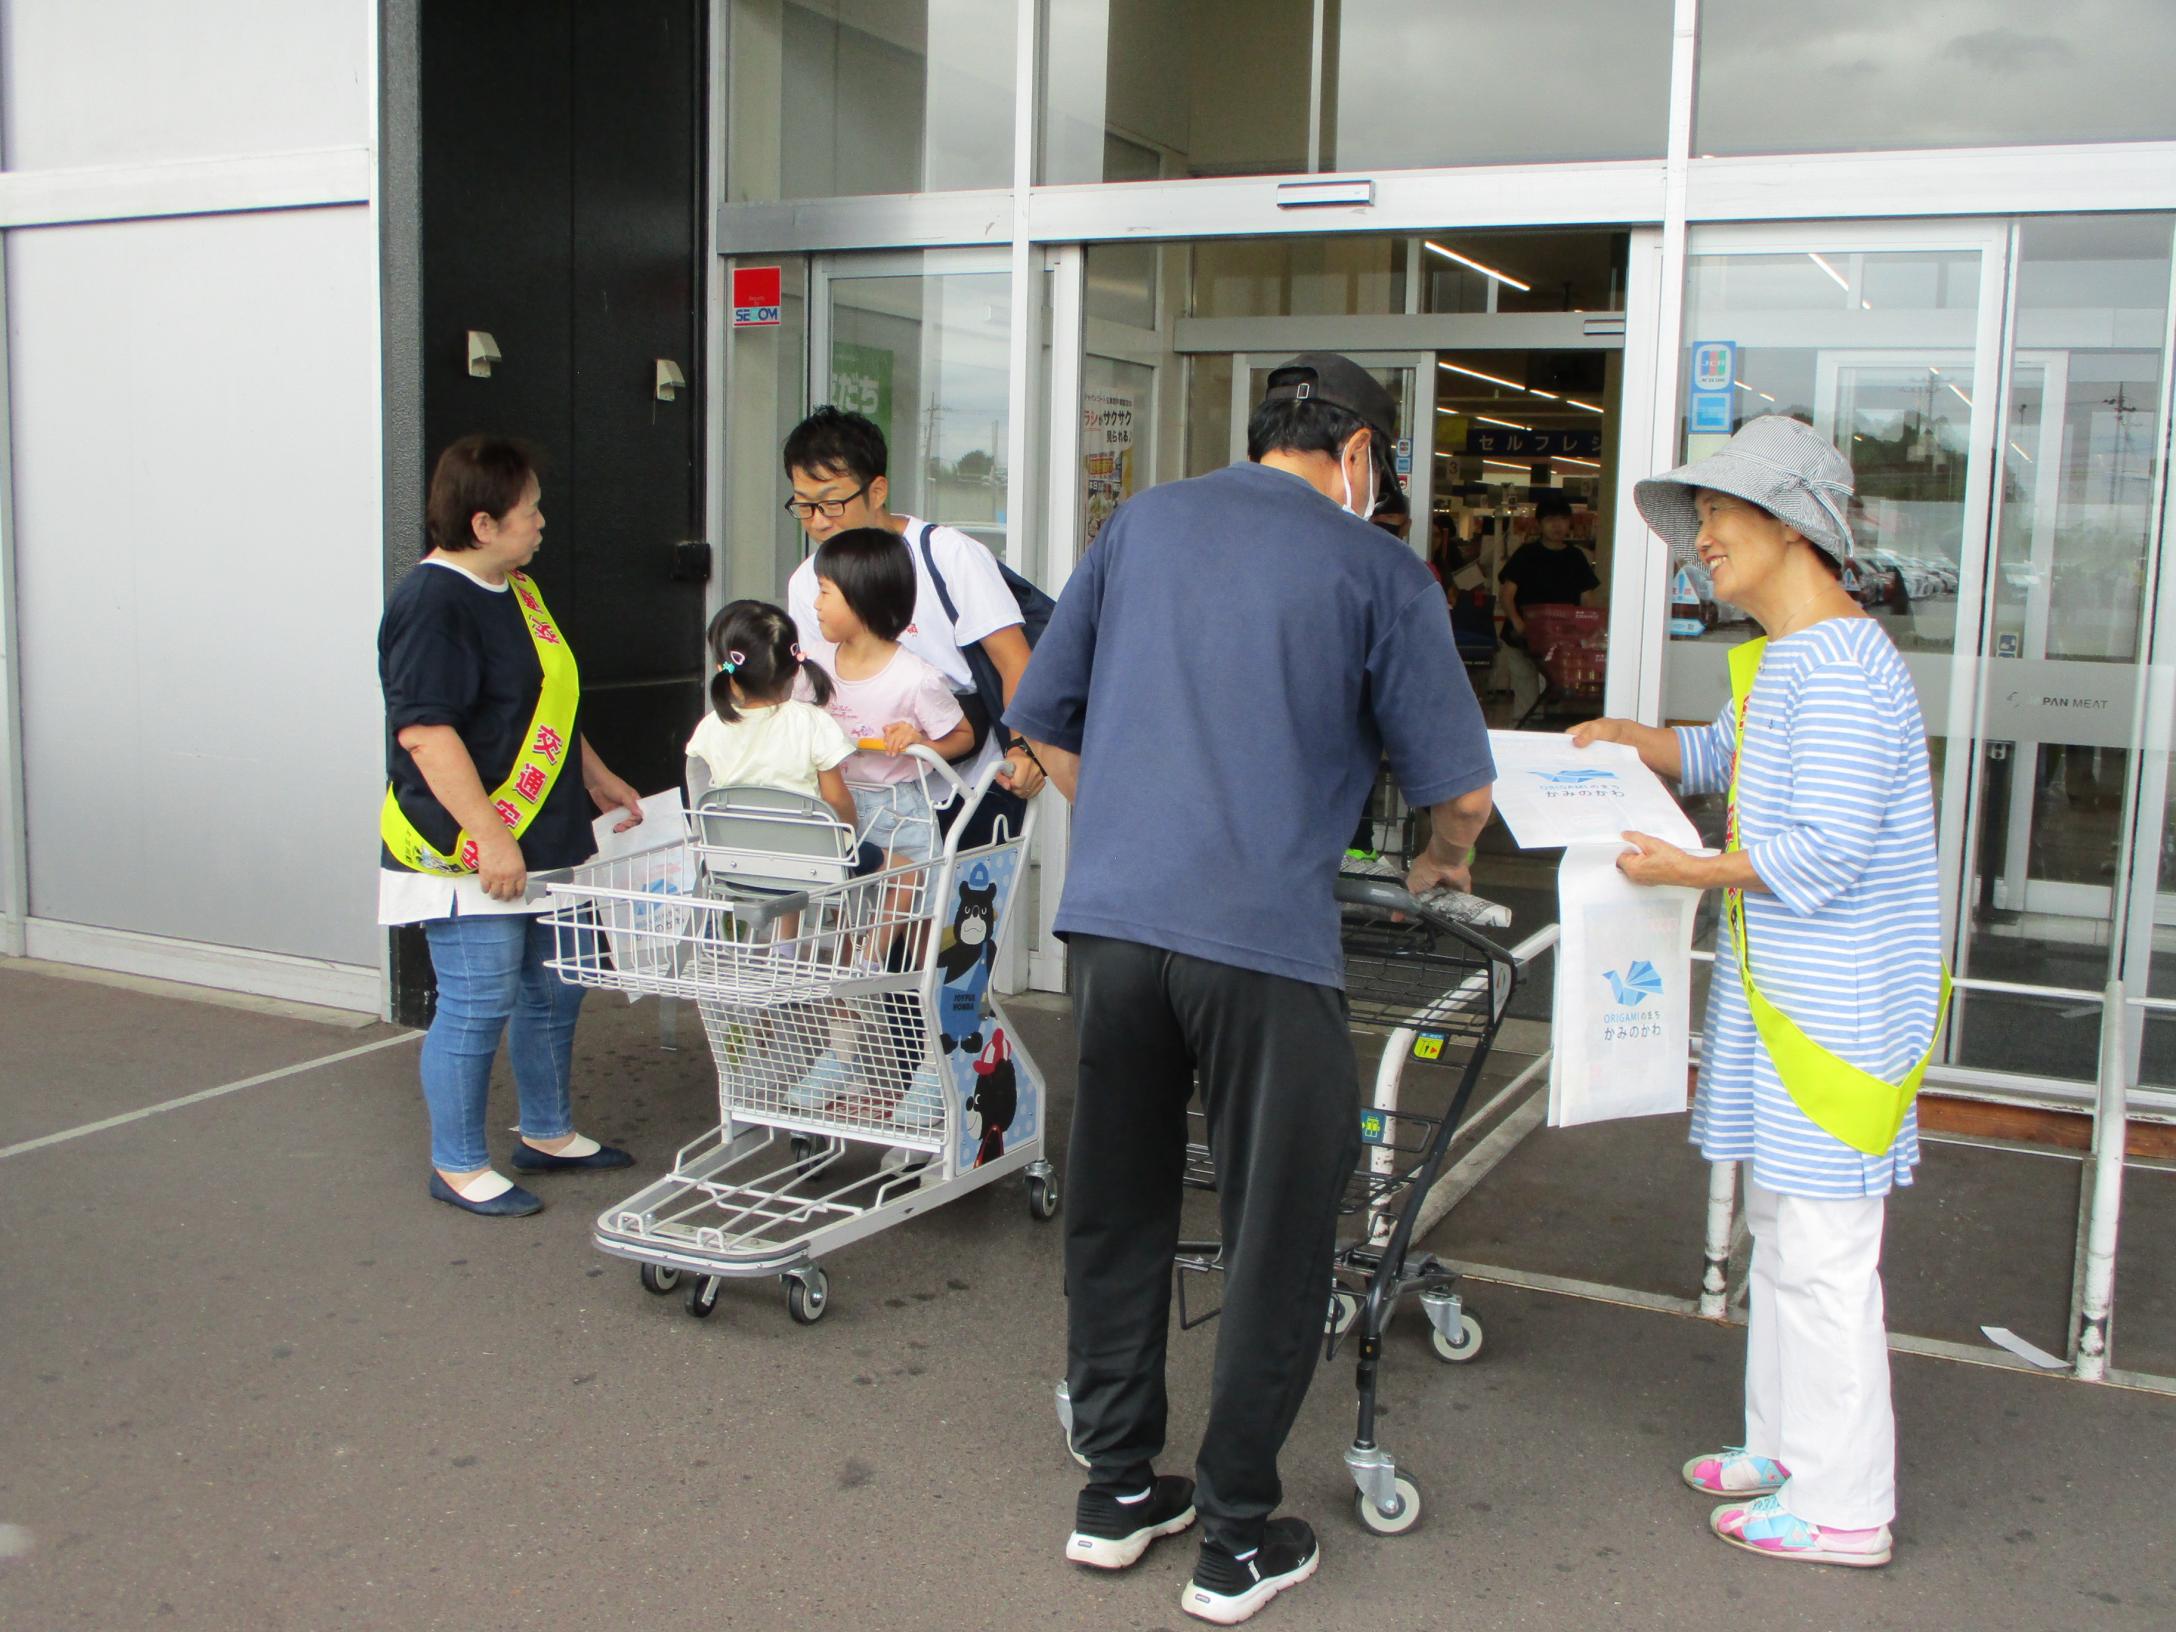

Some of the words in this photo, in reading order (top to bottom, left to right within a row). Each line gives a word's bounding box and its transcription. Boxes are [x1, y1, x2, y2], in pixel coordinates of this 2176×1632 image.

[2072, 697, 2109, 710] MEAT
[1604, 1023, 1662, 1041] かみのかわ
